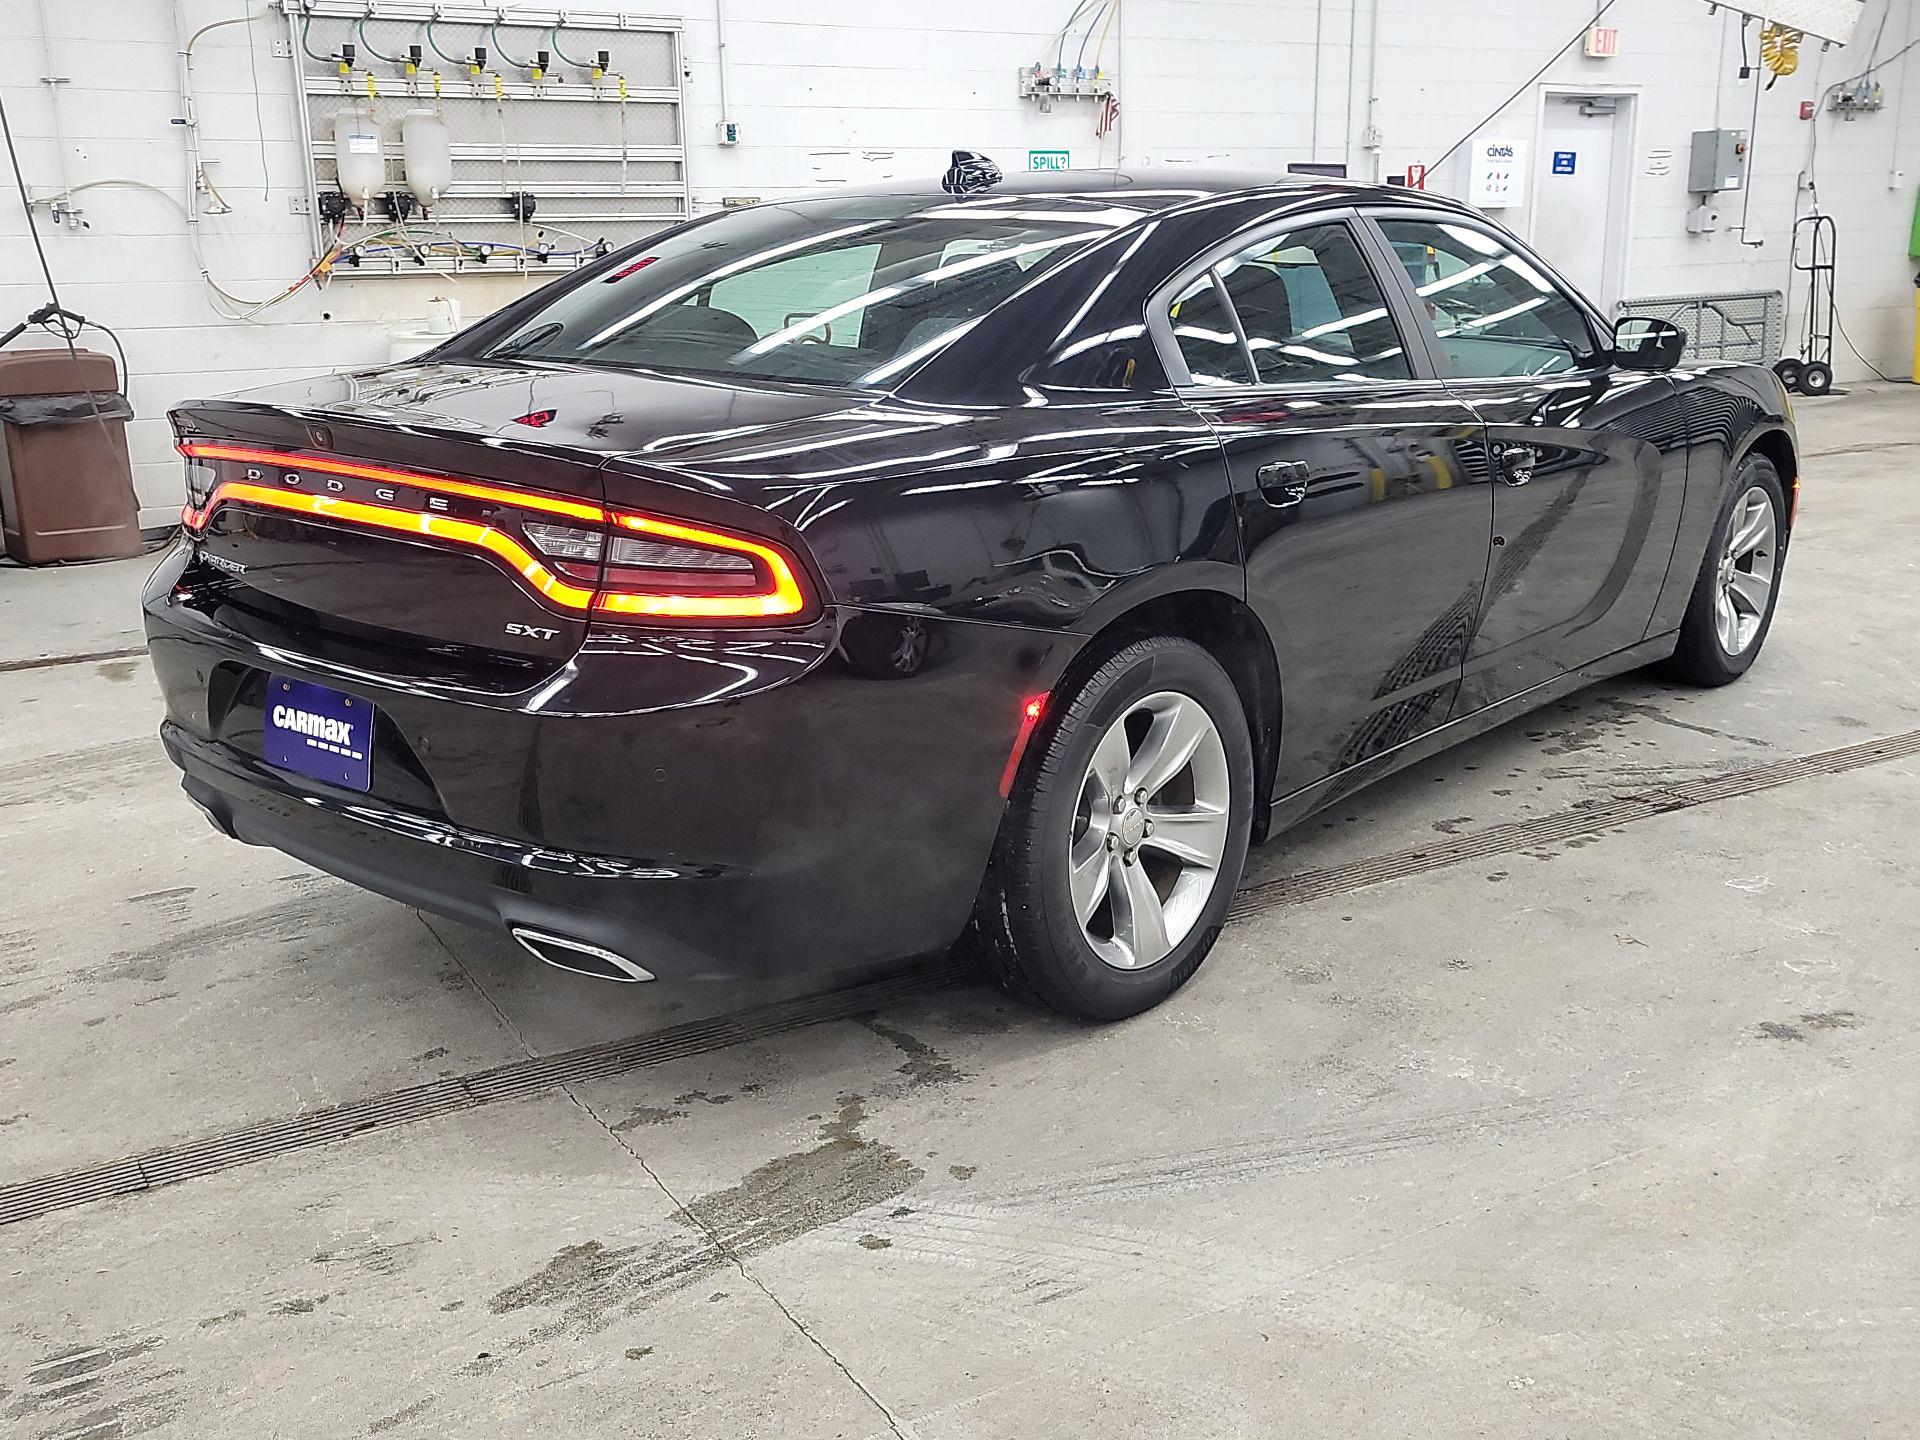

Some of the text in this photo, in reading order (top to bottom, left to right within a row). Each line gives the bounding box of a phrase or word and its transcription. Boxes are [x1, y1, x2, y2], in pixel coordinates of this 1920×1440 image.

[1033, 156, 1066, 170] SPILL?
[247, 468, 449, 512] DODGE
[504, 623, 561, 640] SXT
